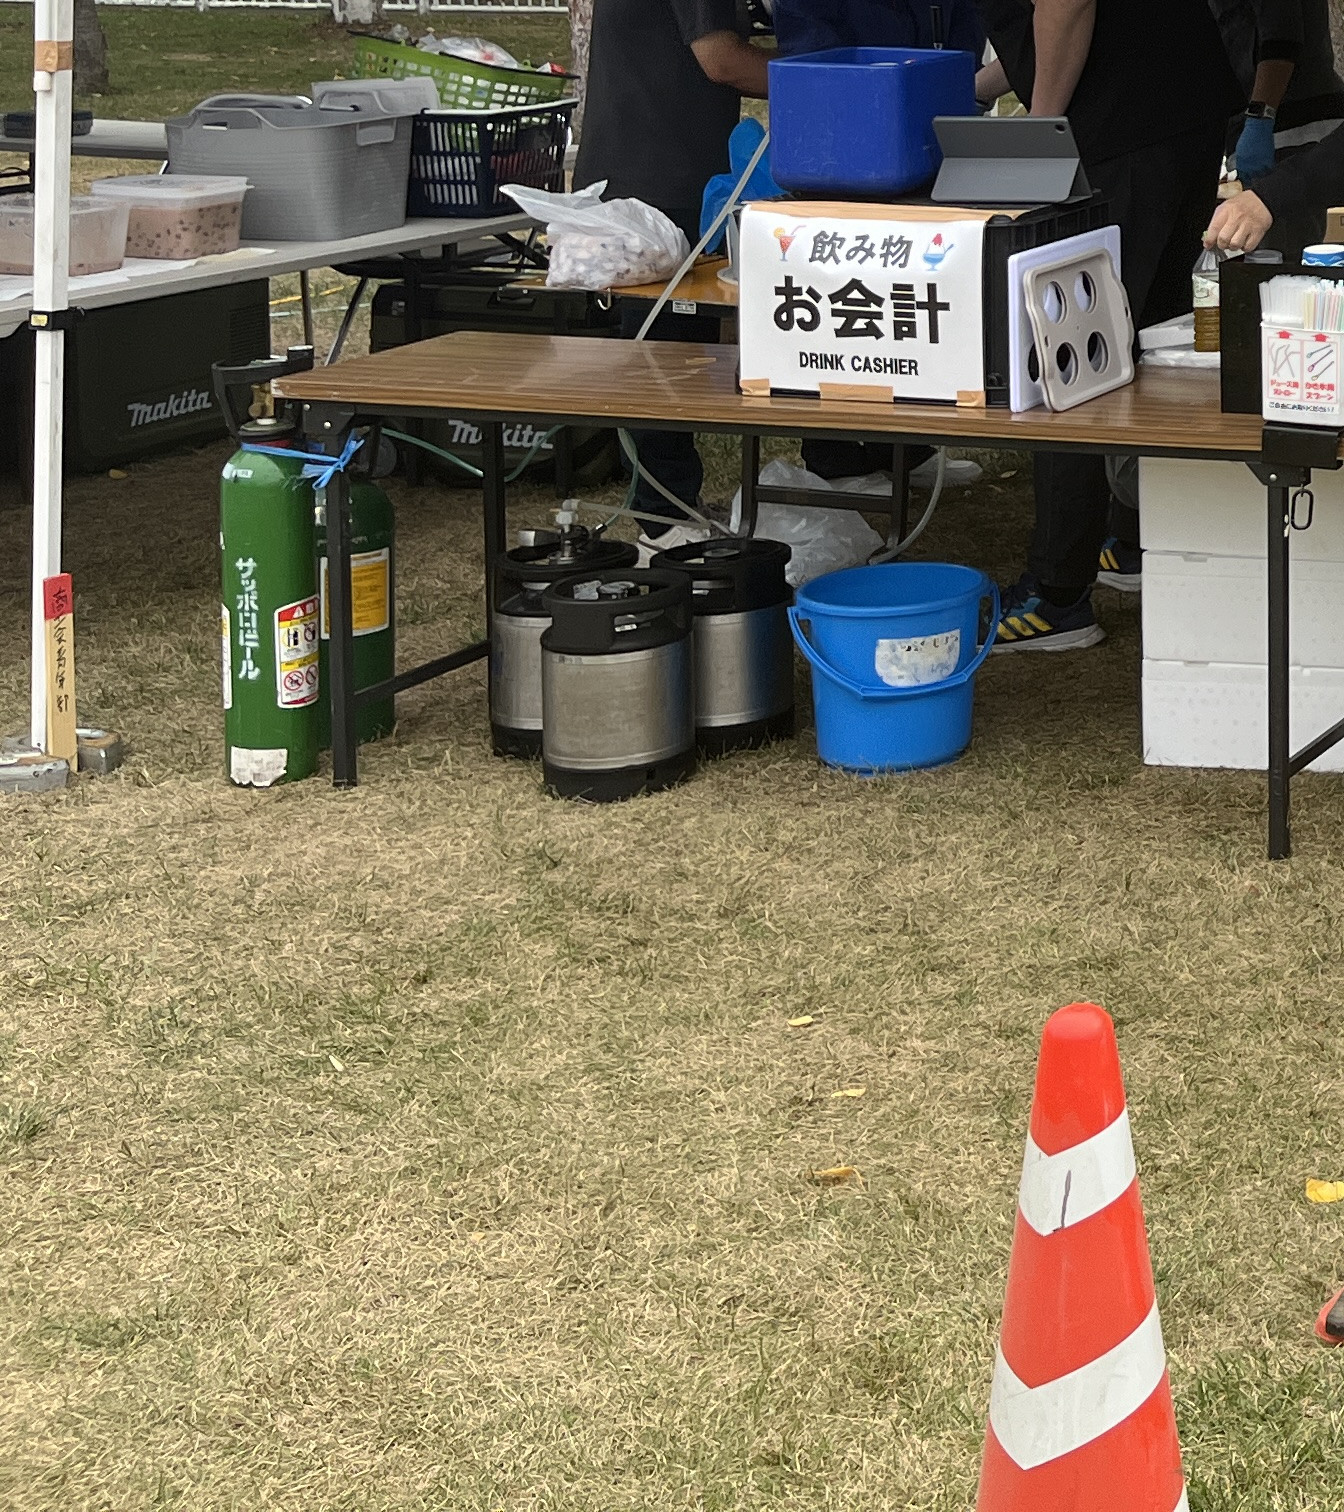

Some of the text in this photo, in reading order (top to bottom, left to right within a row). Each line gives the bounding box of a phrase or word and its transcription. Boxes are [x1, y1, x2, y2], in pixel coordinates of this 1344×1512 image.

[809, 230, 913, 268] 飲み物
[773, 275, 950, 344] お会計
[799, 352, 919, 376] DRINK CASHIER
[448, 419, 554, 449] mkita
